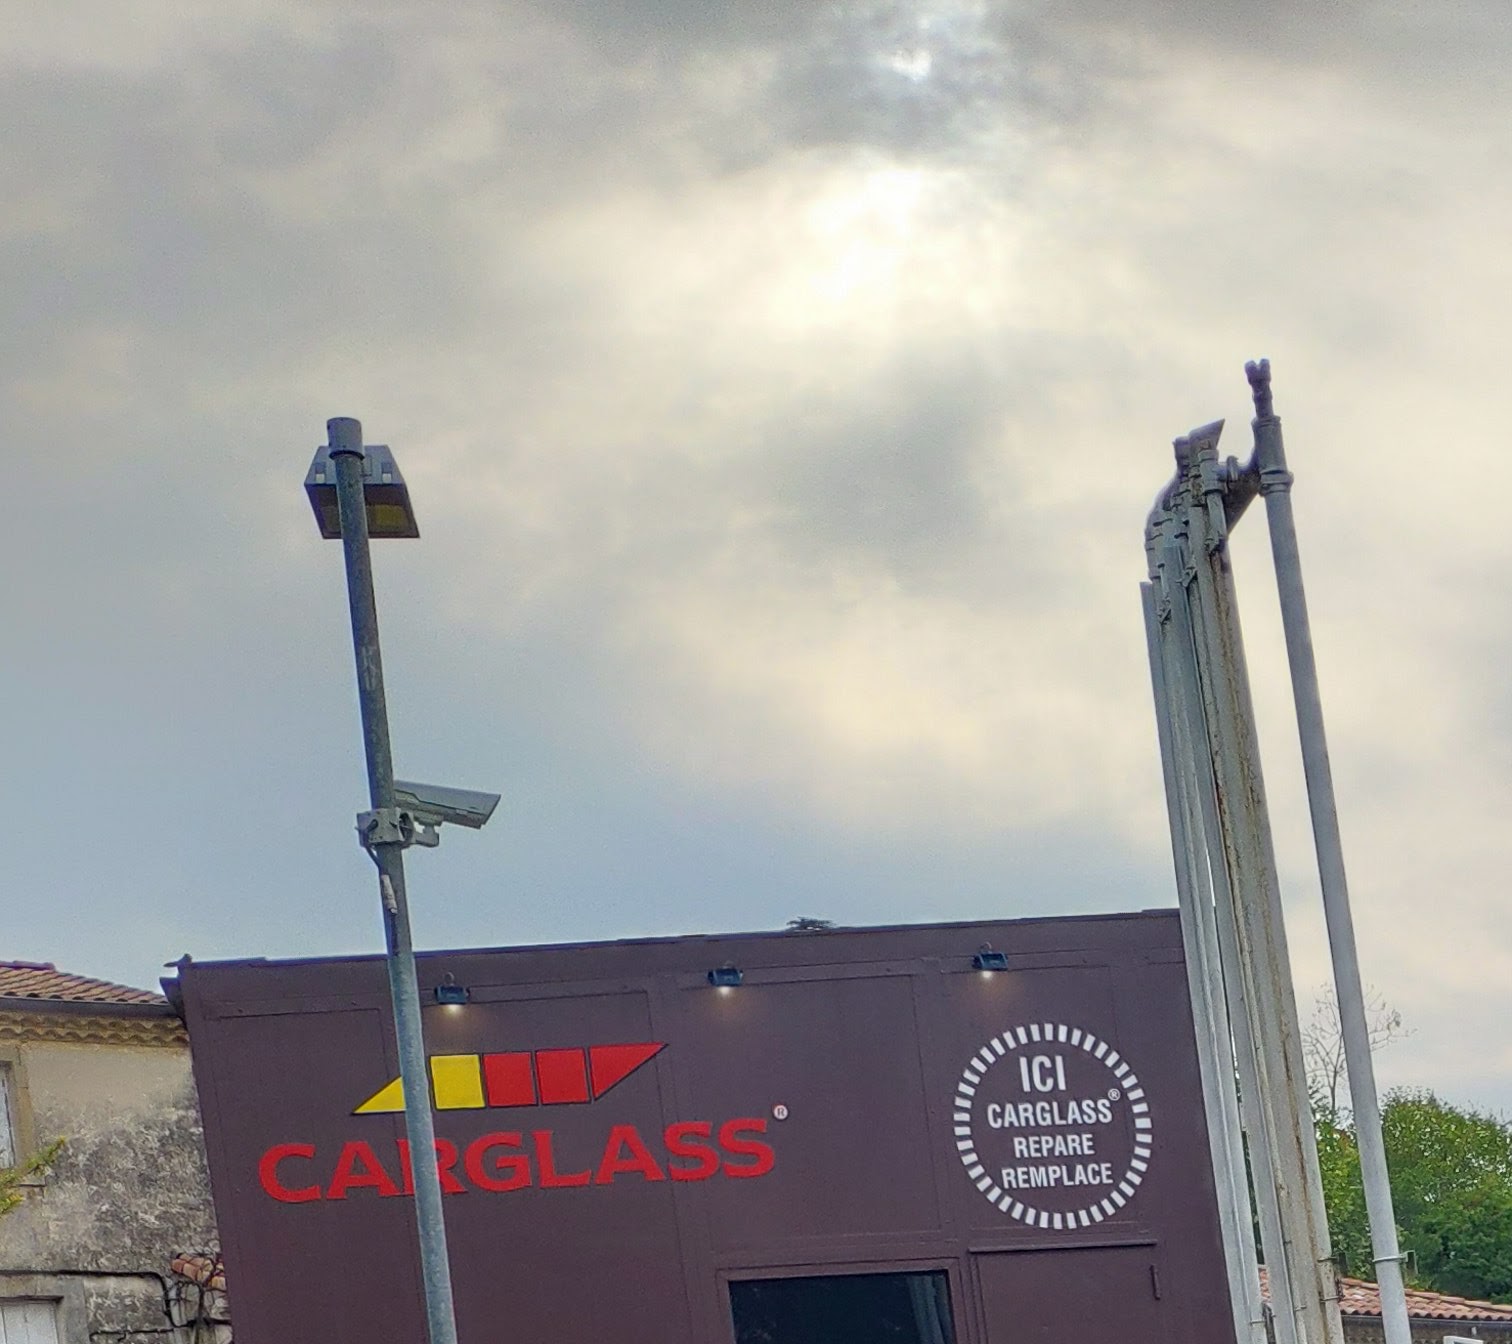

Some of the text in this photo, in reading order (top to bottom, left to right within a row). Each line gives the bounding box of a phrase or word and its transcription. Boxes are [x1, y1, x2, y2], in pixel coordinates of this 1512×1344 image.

[1019, 1055, 1067, 1093] ICI
[1013, 1133, 1095, 1159] REPARE
[1001, 1163, 1114, 1189] REMPLACE
